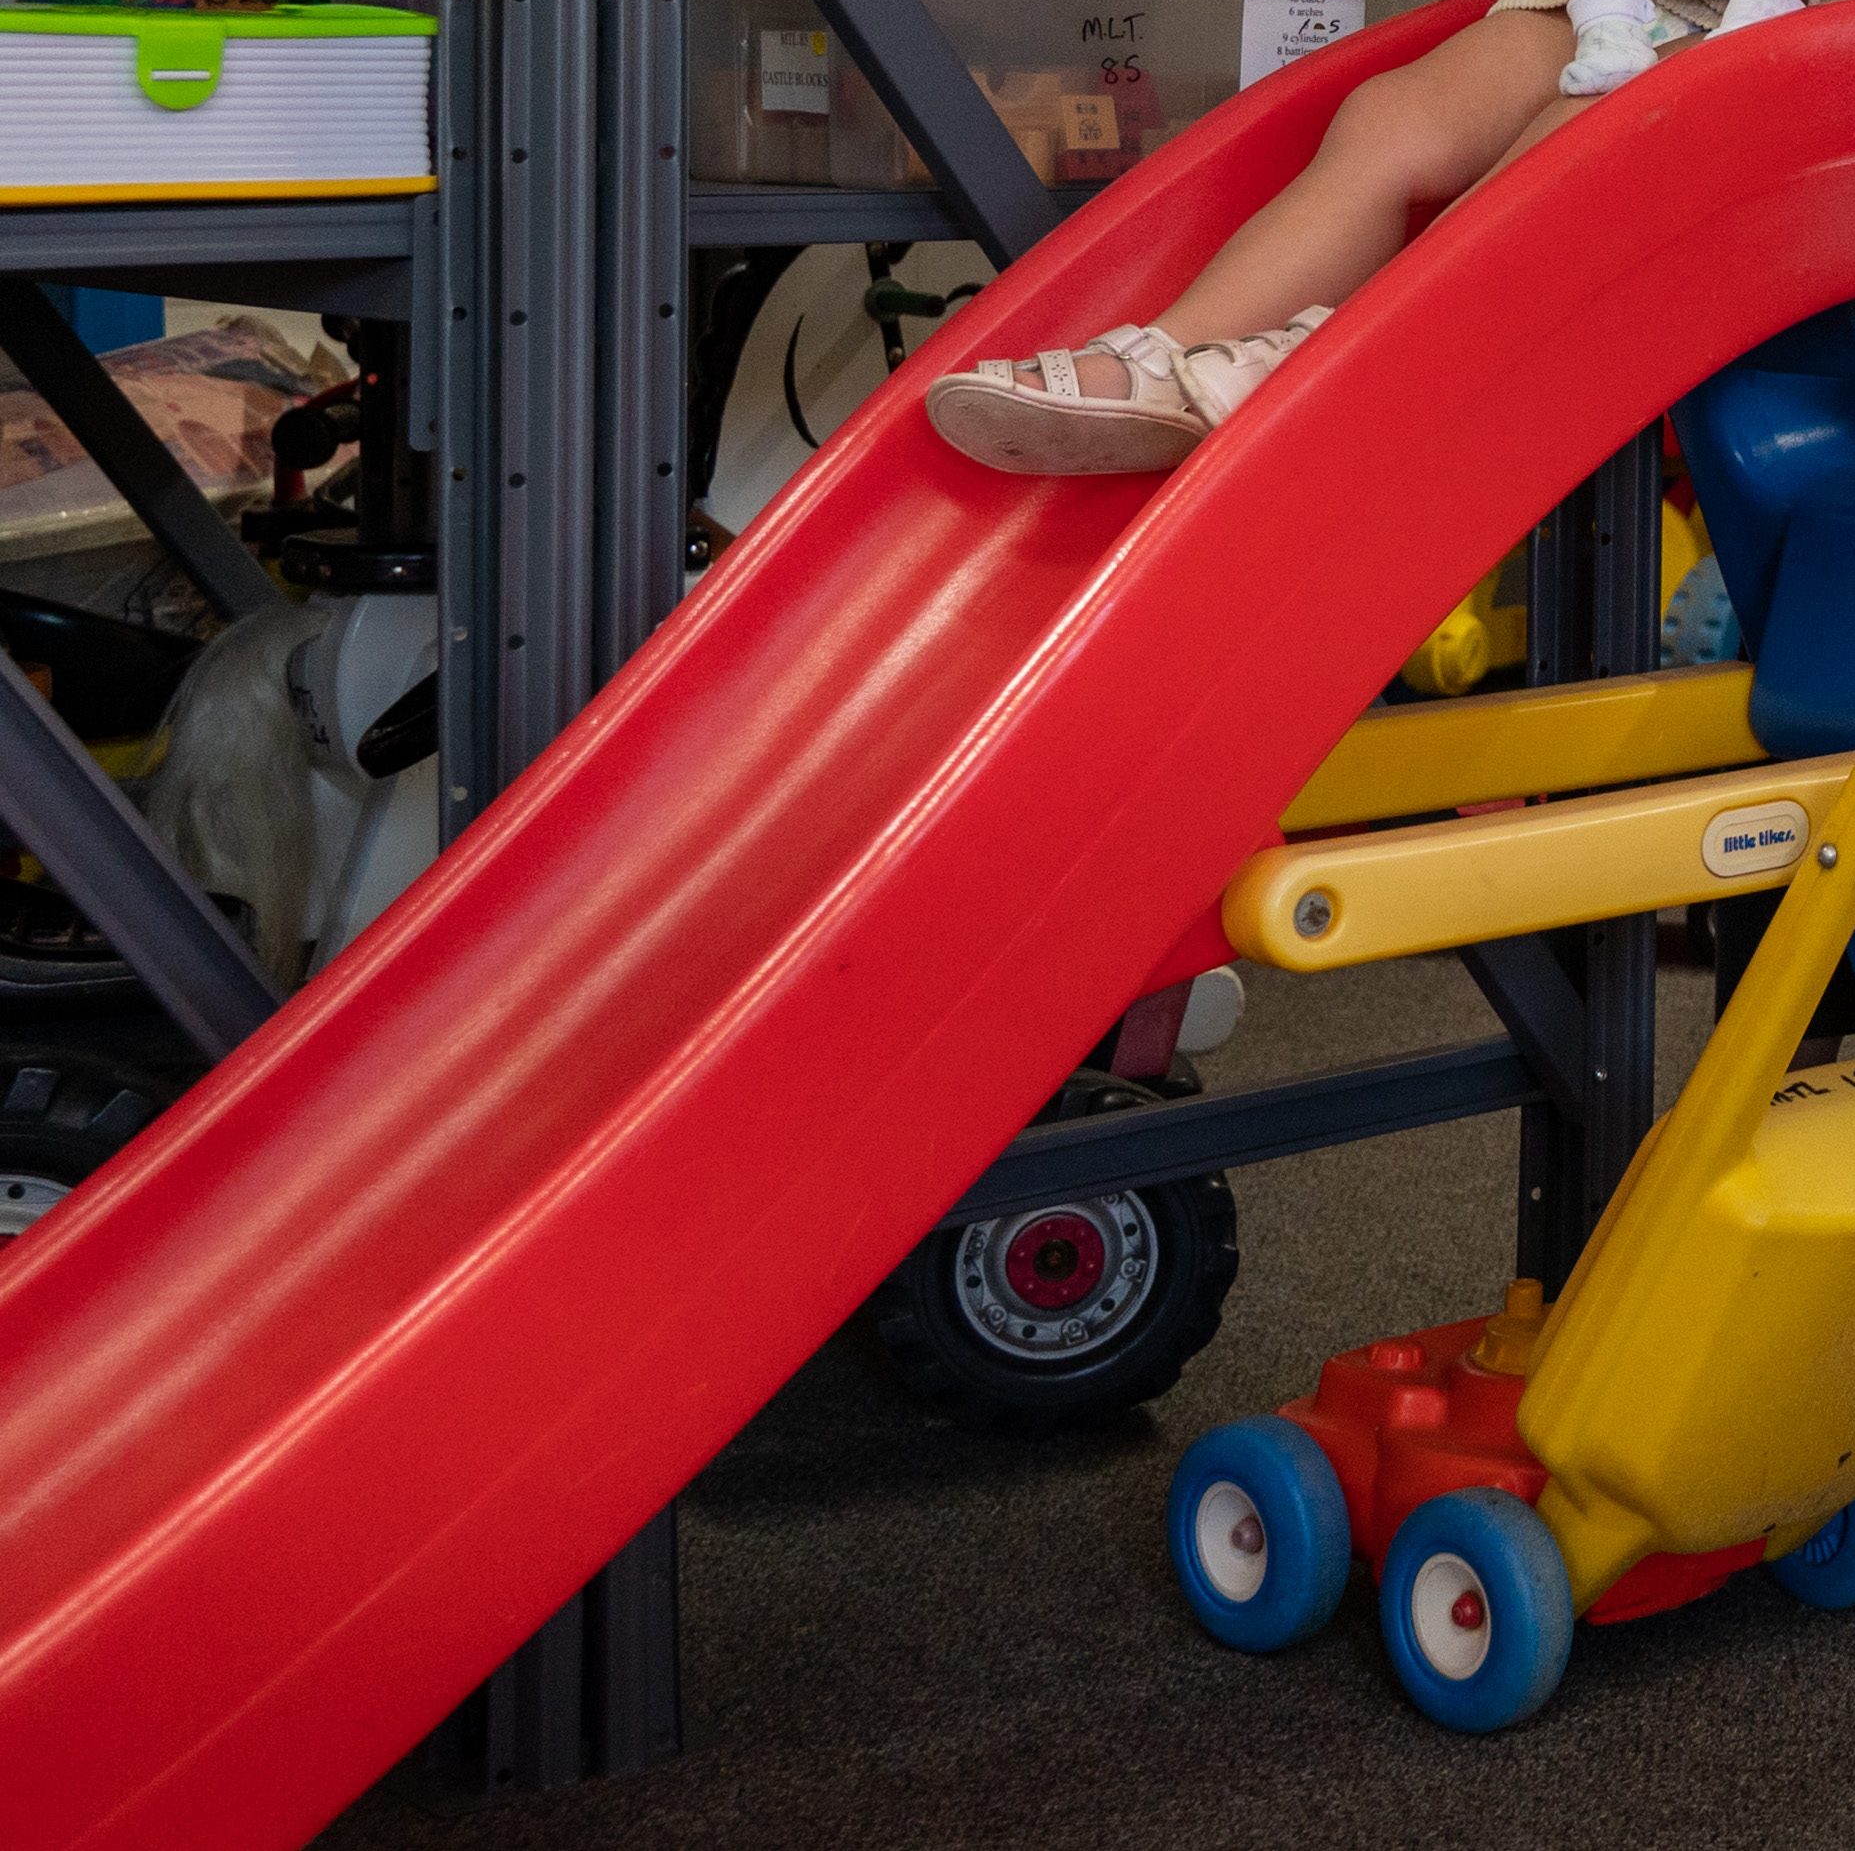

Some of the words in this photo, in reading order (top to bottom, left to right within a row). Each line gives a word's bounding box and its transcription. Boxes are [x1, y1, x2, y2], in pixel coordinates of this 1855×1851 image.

[1296, 7, 1324, 17] arches
[1290, 33, 1328, 45] cylinders
[762, 70, 793, 86] CASTLE
[794, 70, 831, 88] BLOCKS
[1100, 54, 1142, 85] 85
[1723, 833, 1757, 854] little
[1769, 1080, 1832, 1107] MTL
